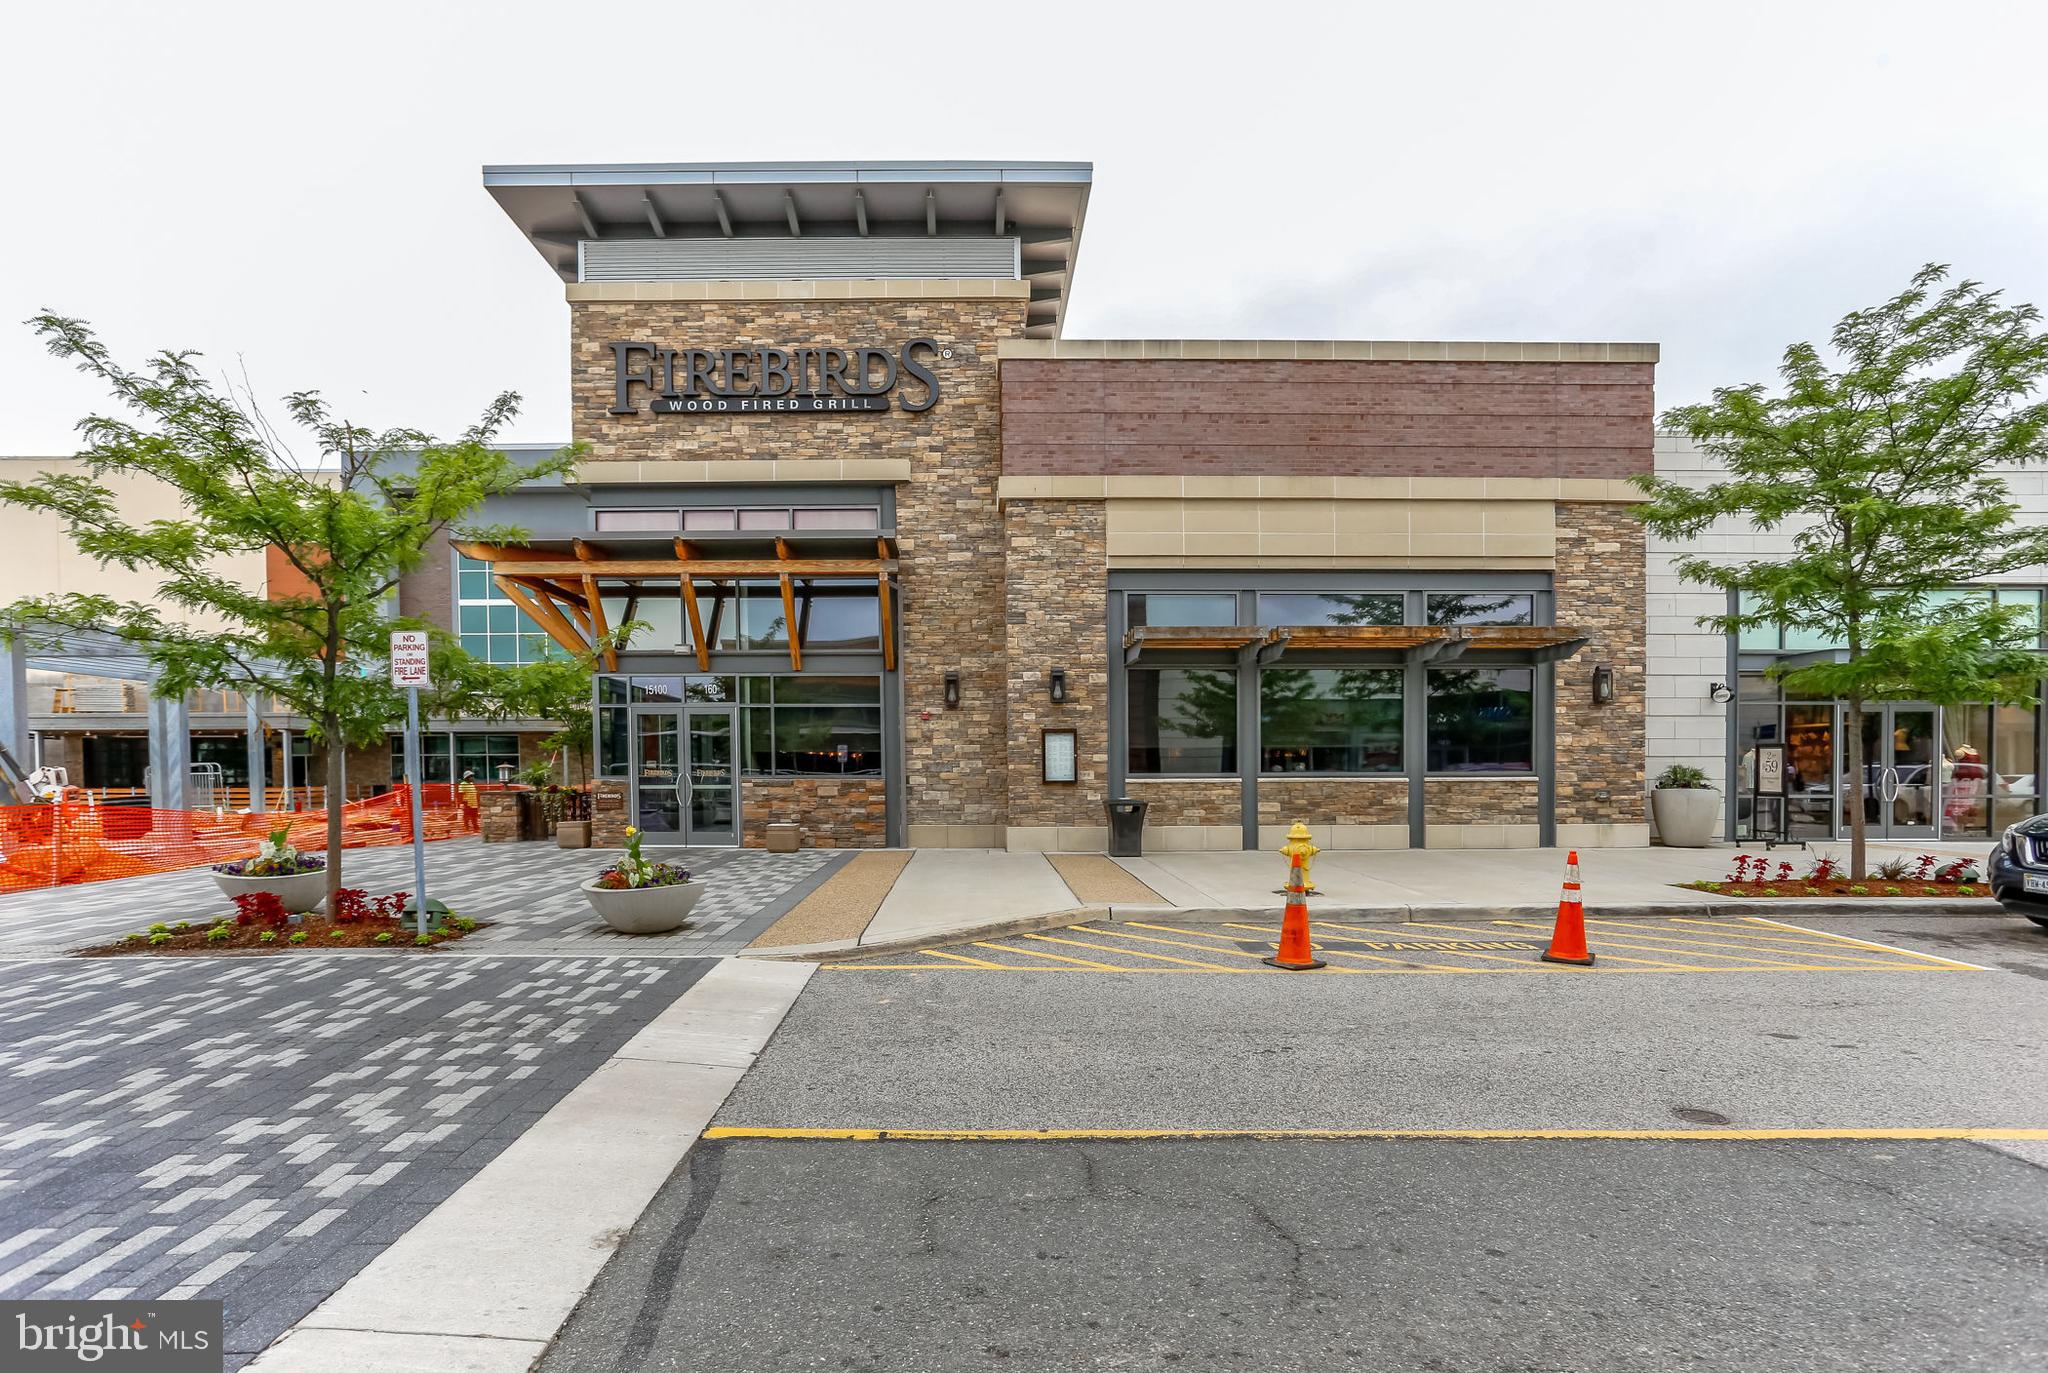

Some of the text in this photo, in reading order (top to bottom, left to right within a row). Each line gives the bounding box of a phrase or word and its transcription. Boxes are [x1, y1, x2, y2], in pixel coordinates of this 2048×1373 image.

[608, 338, 940, 414] FIREBIRDS
[669, 398, 872, 411] WOOD FIRED GRILL
[403, 635, 415, 643] NO
[394, 667, 426, 675] FIRE LANE
[645, 684, 668, 695] 15100
[704, 684, 717, 694] 160
[1364, 942, 1539, 950] PARKING
